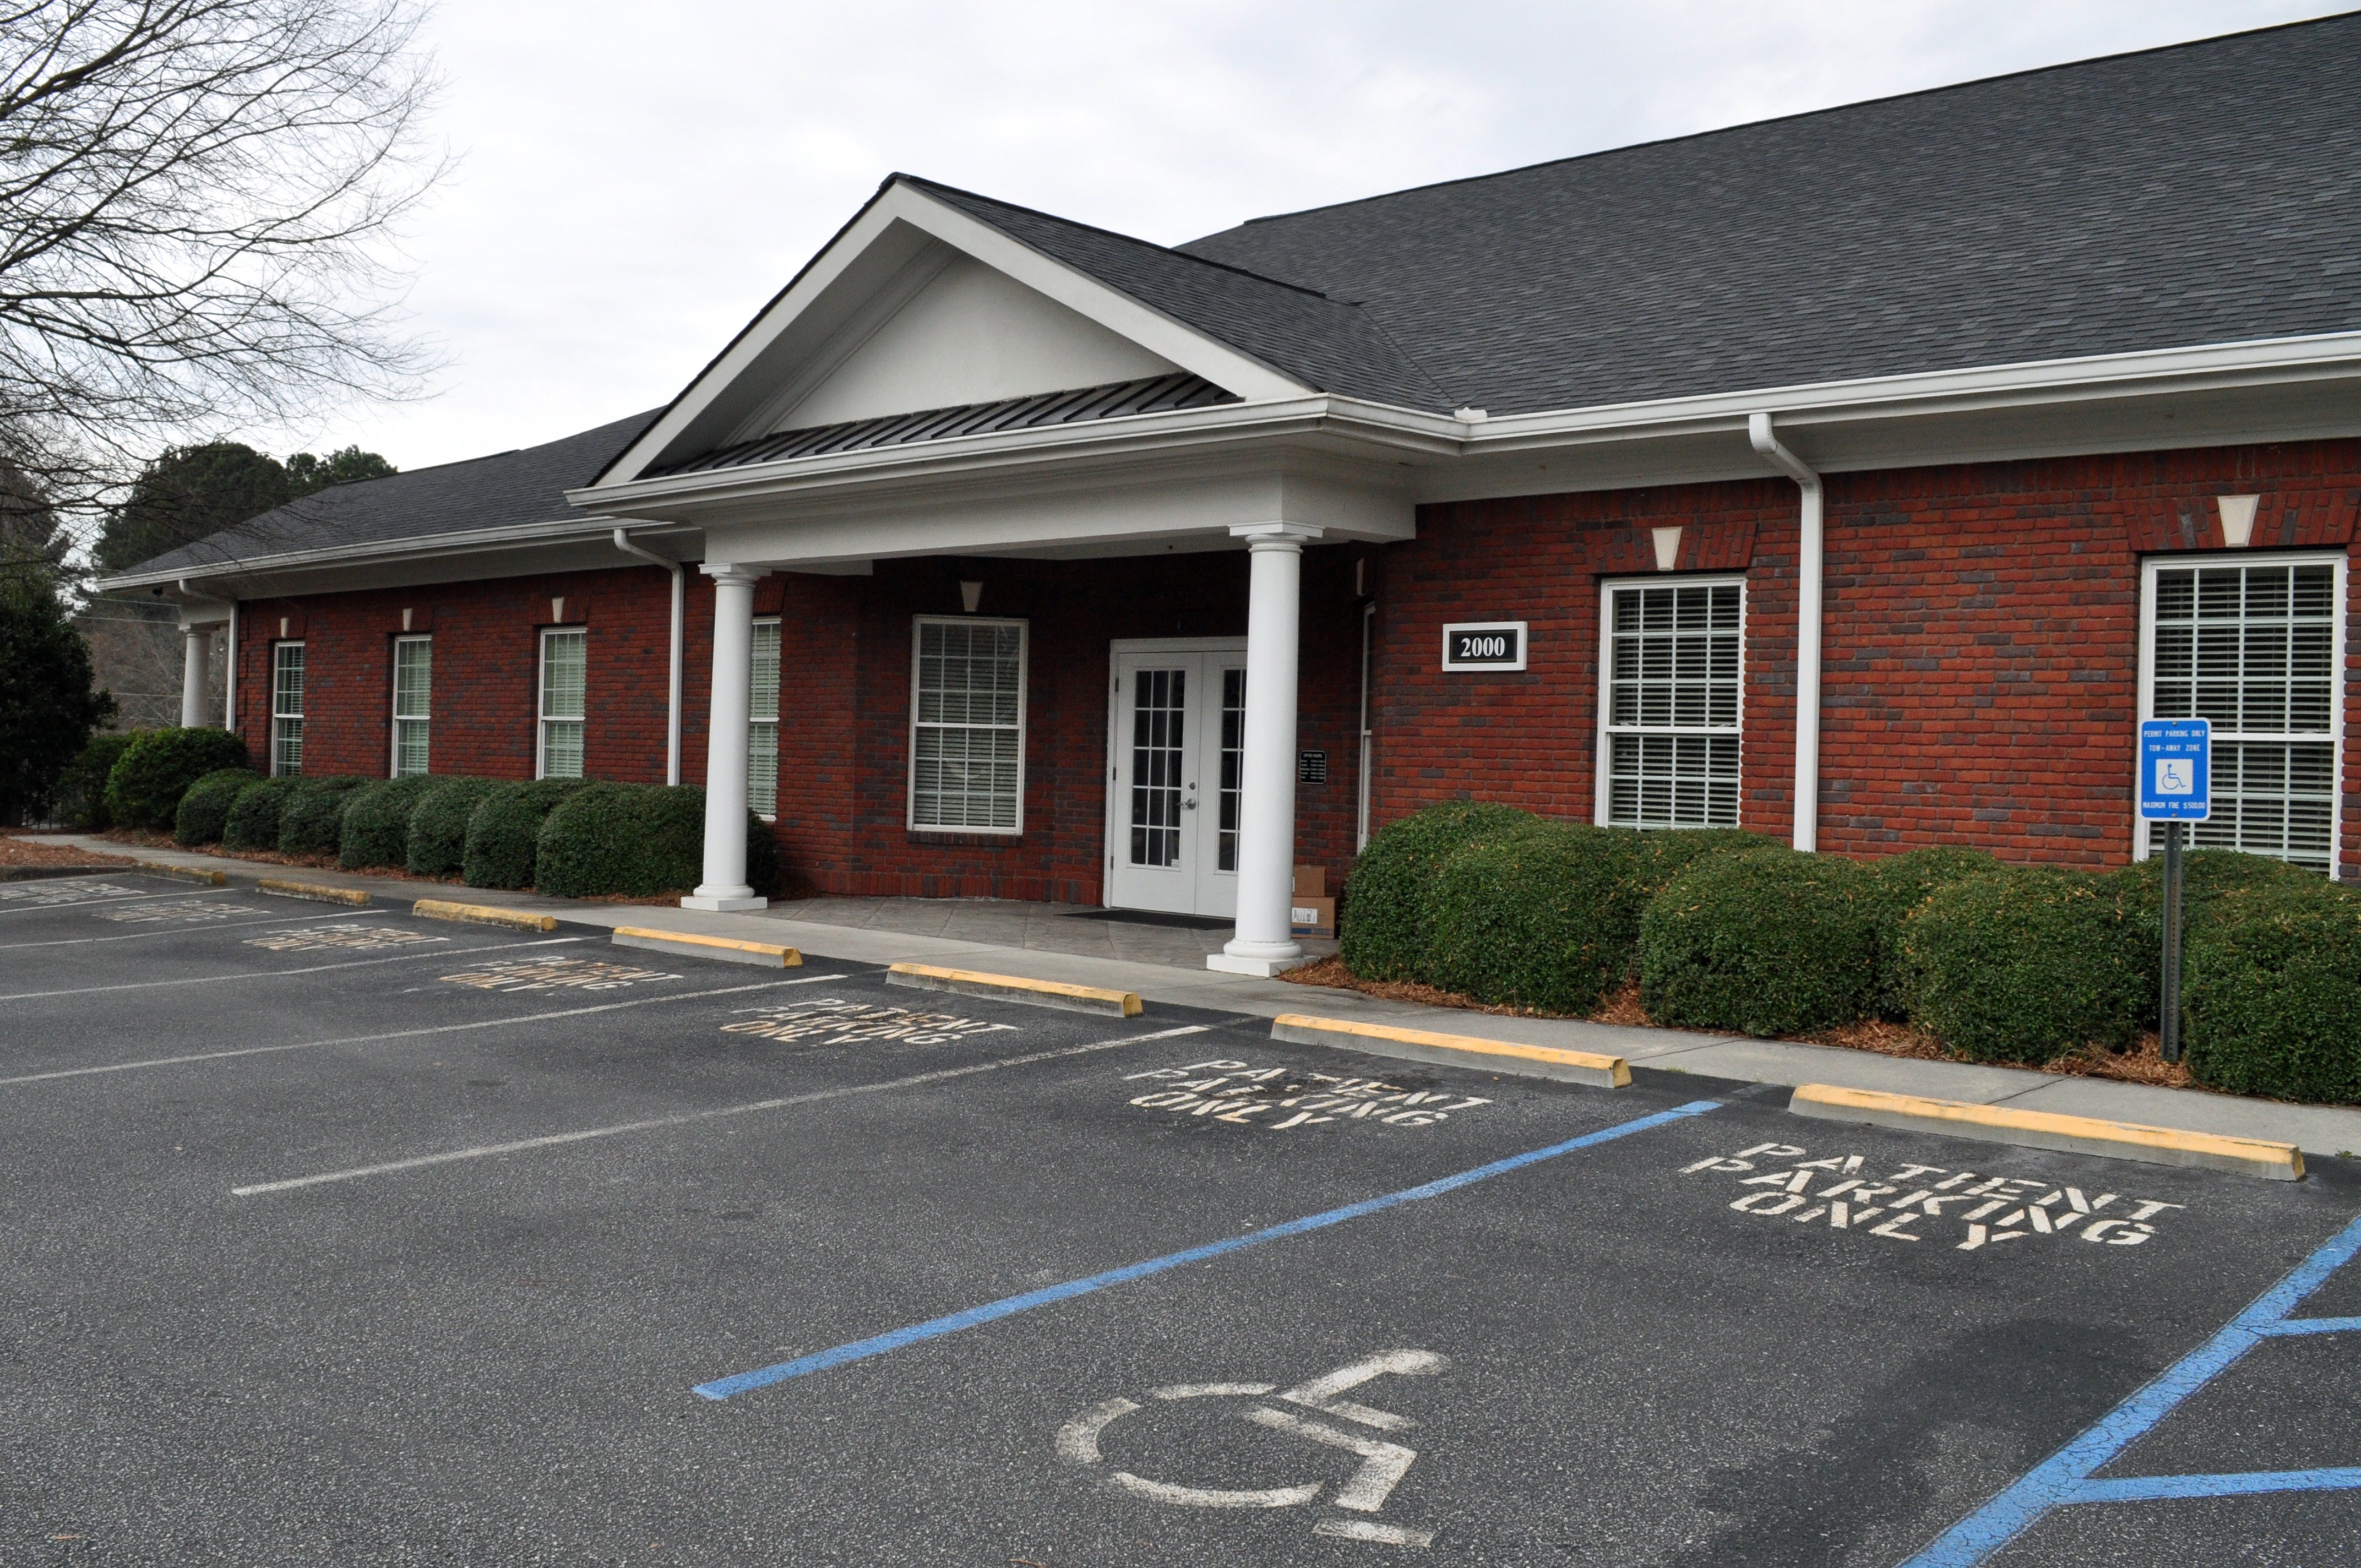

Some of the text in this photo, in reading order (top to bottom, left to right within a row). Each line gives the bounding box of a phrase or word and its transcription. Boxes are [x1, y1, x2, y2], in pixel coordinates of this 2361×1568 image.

[1461, 637, 1505, 657] 2000
[1129, 1091, 1335, 1129] ONLY
[1677, 1157, 2156, 1245] PARKING
[1733, 1142, 2185, 1220] PATIENT
[1729, 1191, 2029, 1250] ONLY
